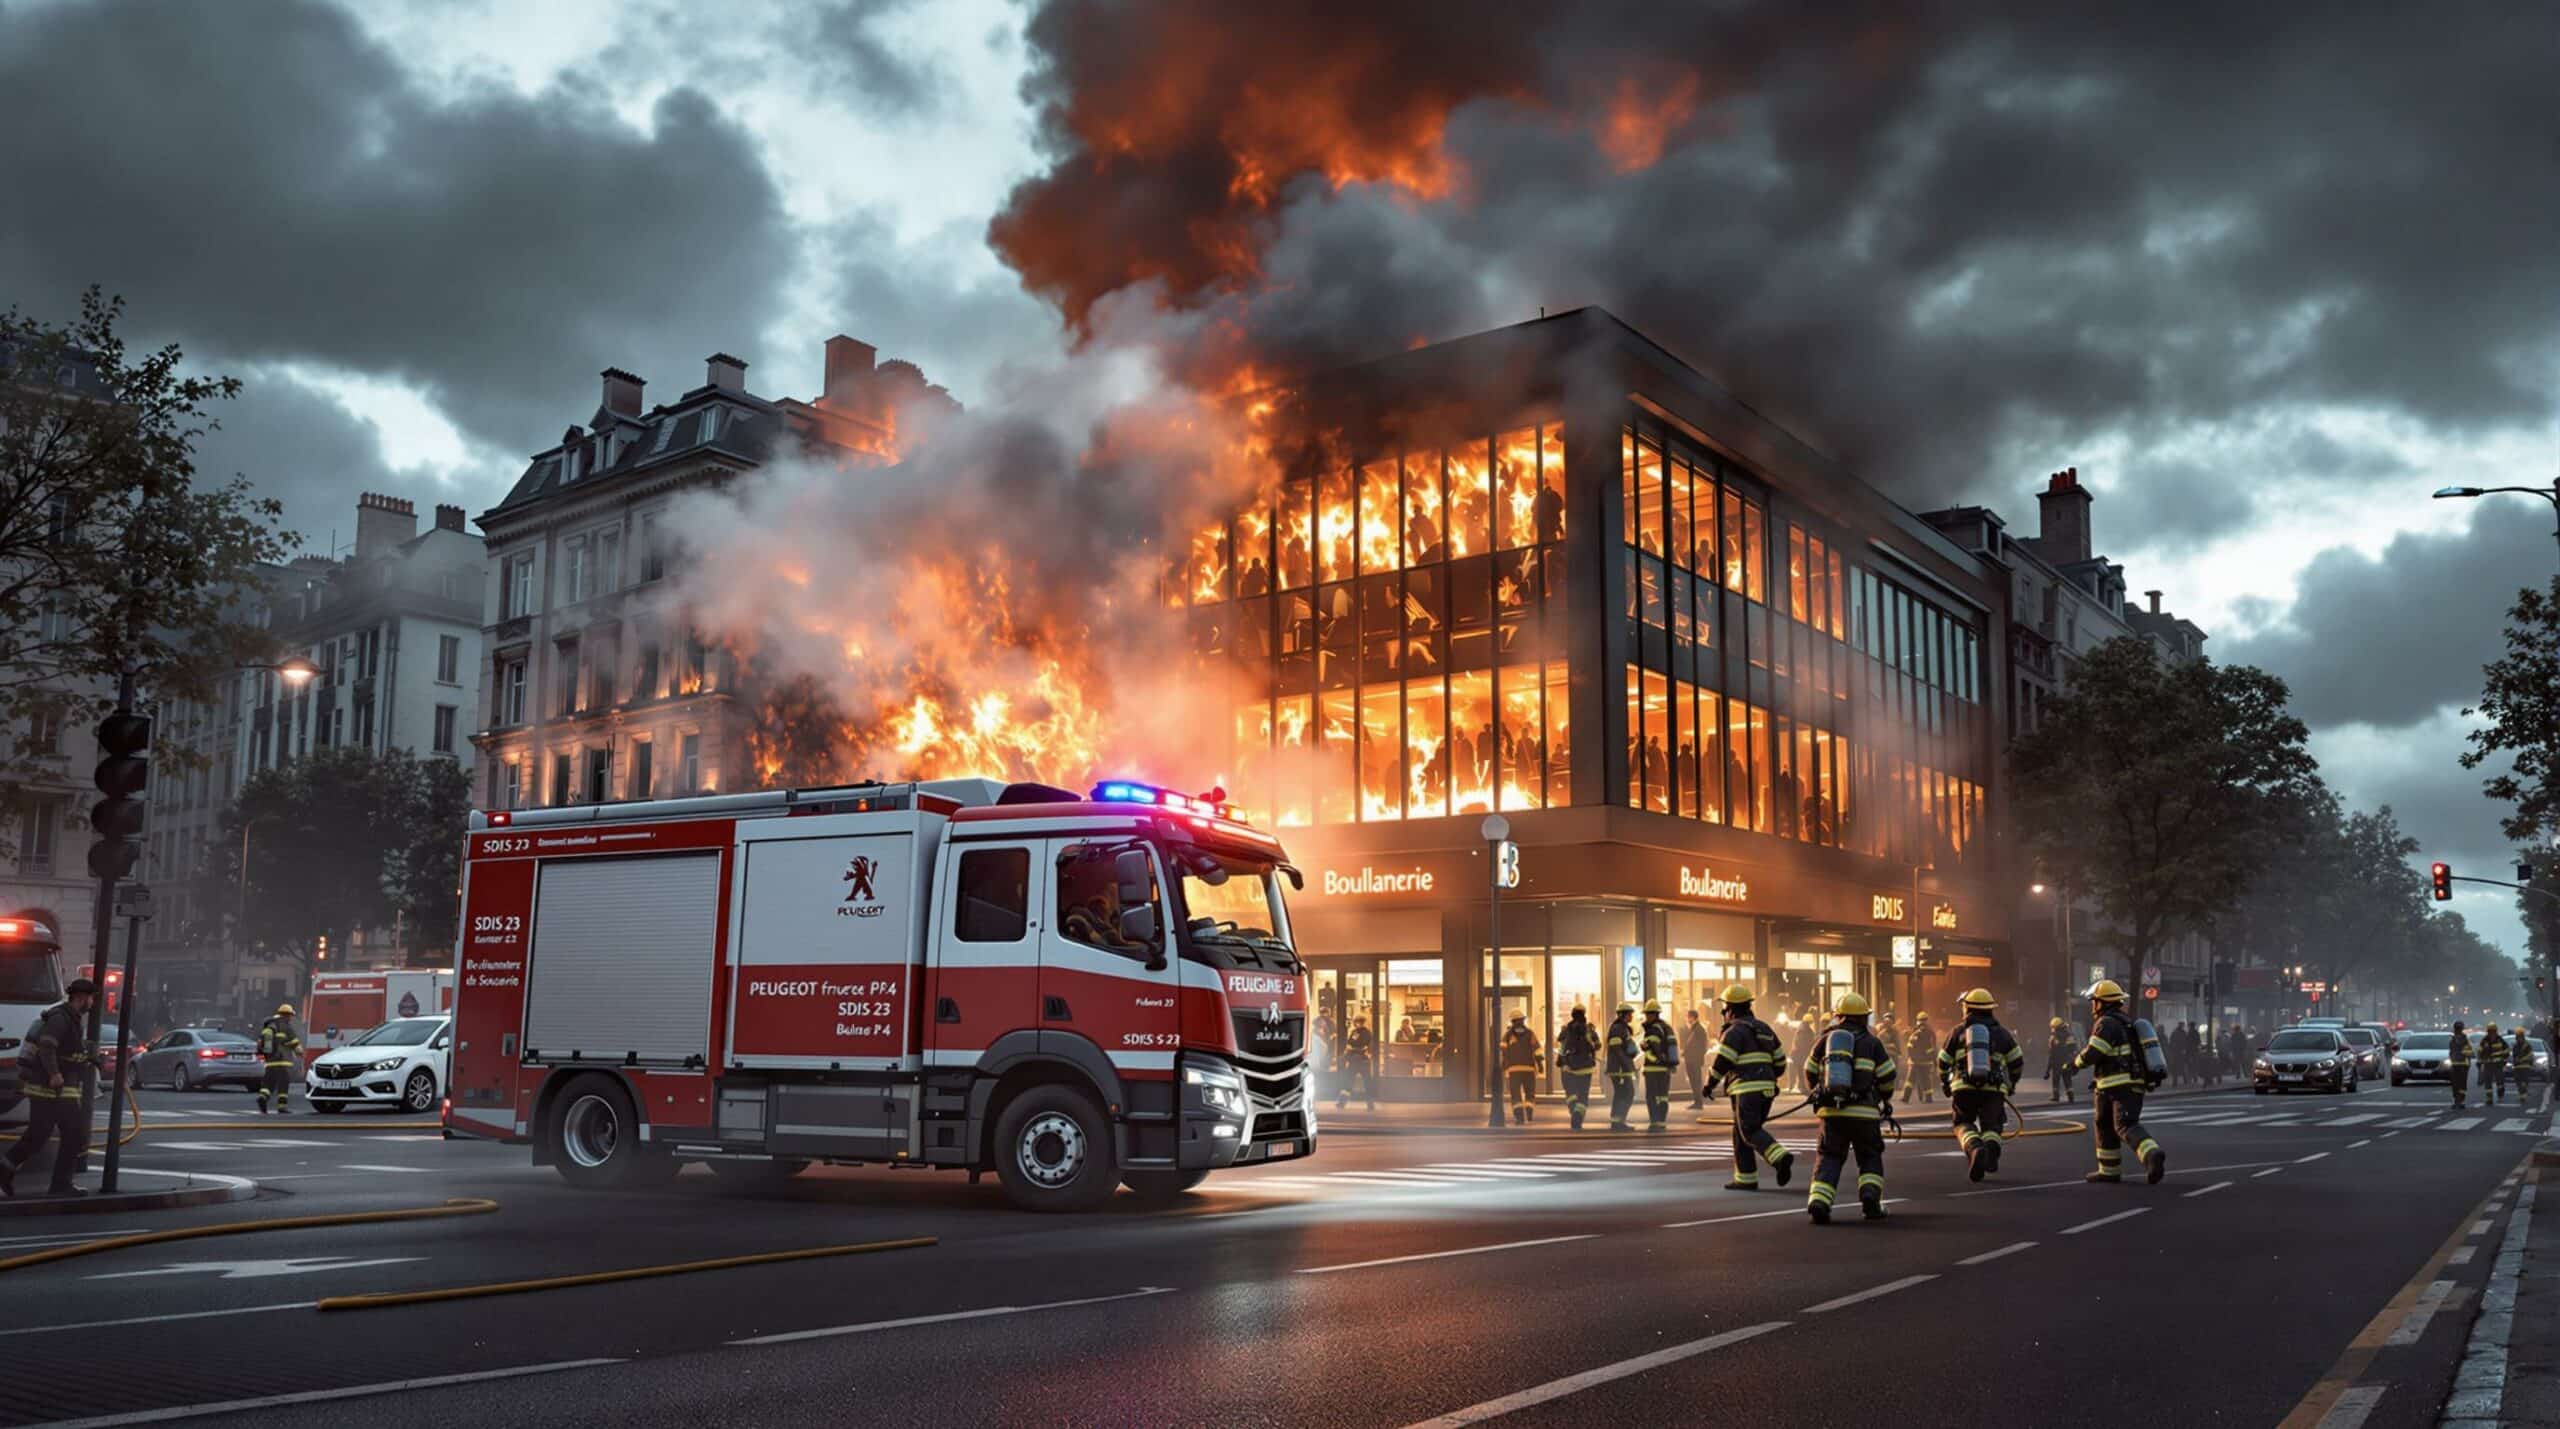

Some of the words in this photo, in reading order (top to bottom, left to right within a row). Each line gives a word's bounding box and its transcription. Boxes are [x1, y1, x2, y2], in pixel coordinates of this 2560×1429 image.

[483, 839, 512, 853] SDIS
[475, 916, 503, 931] SDIS
[505, 916, 521, 931] 23
[749, 981, 818, 996] PEUGEOT
[838, 1002, 871, 1016] SDIS
[872, 1002, 891, 1016] 23
